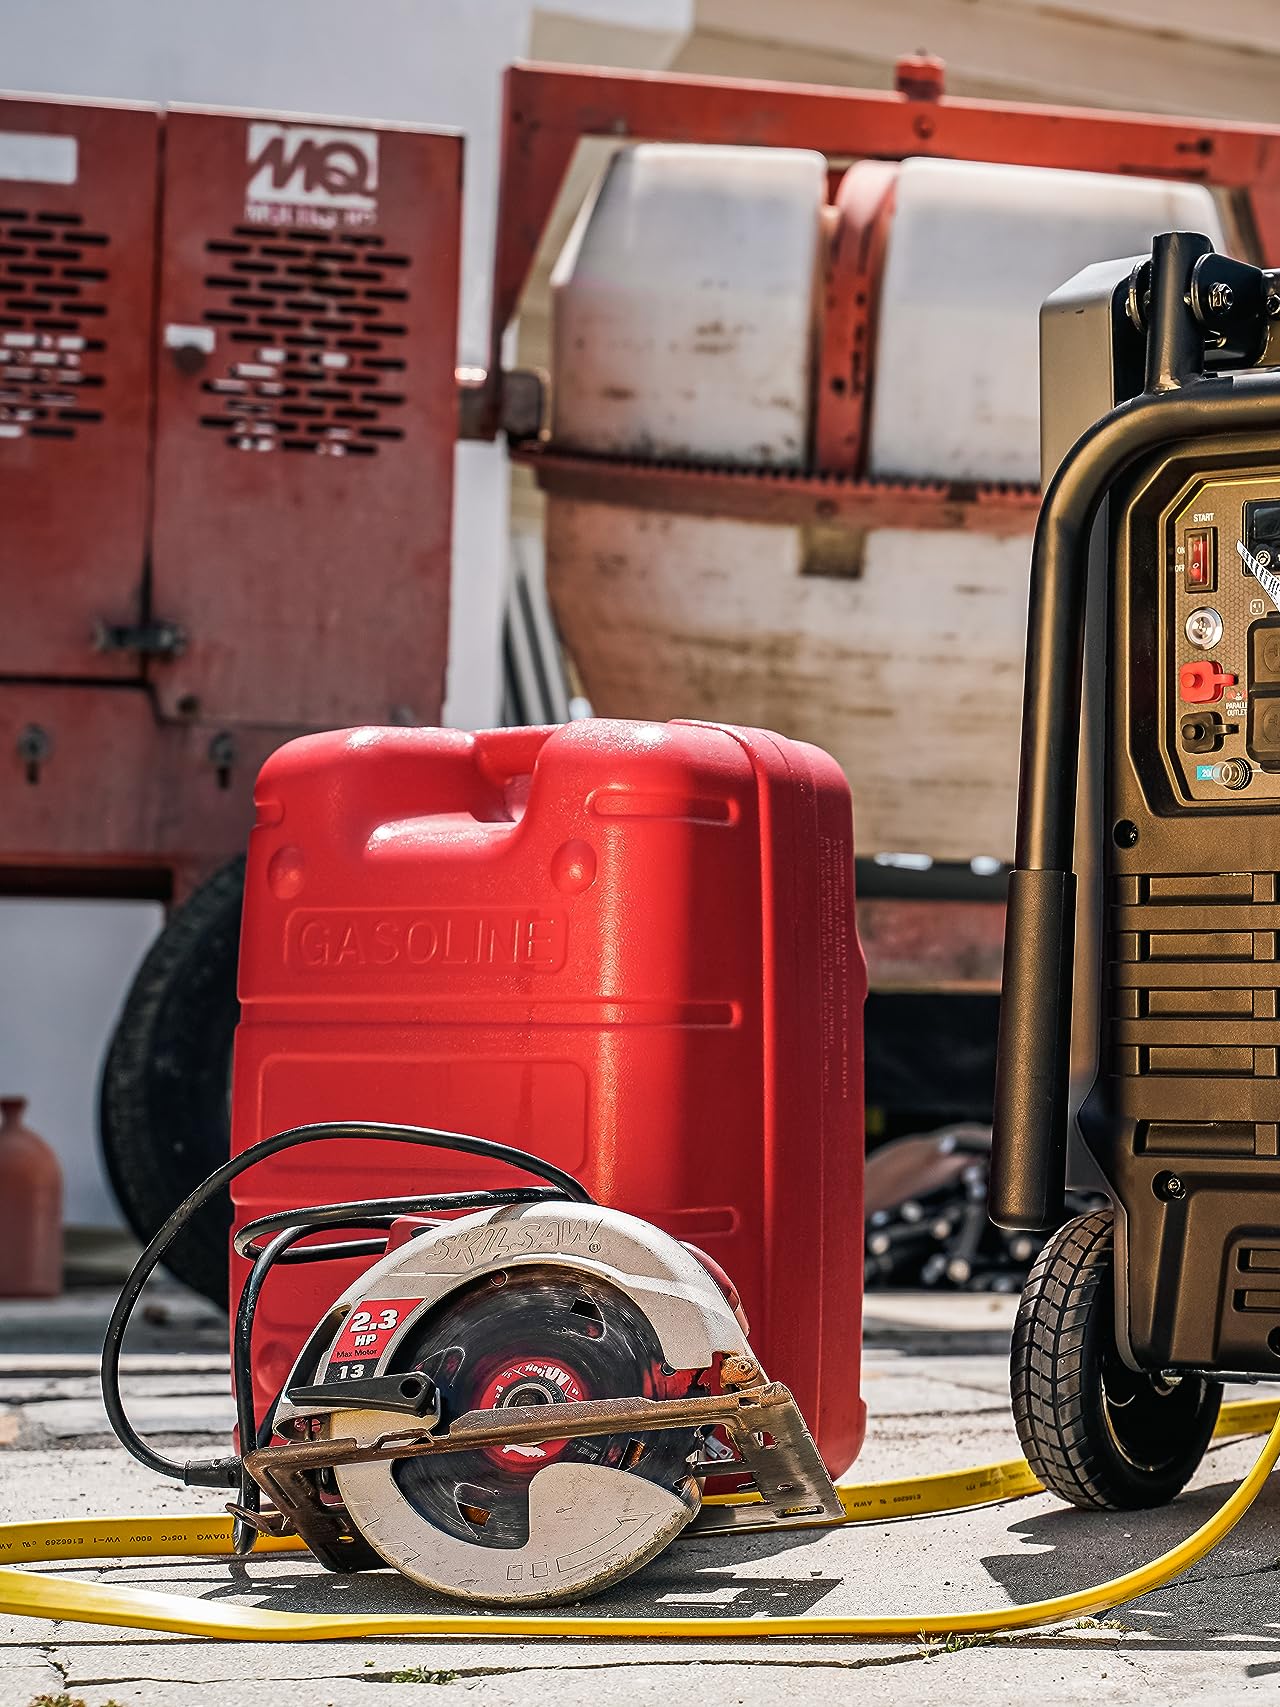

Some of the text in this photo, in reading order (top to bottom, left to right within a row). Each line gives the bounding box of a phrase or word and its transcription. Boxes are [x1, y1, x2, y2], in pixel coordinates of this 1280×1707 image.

[247, 137, 377, 197] MQ
[1193, 512, 1214, 522] START
[1175, 564, 1185, 573] OFF
[301, 919, 554, 966] GASOLINE
[350, 1309, 398, 1332] 2.3
[354, 1334, 377, 1347] HP
[340, 1364, 364, 1380] 13
[854, 1500, 872, 1508] AWM
[45, 1537, 84, 1546] E166269
